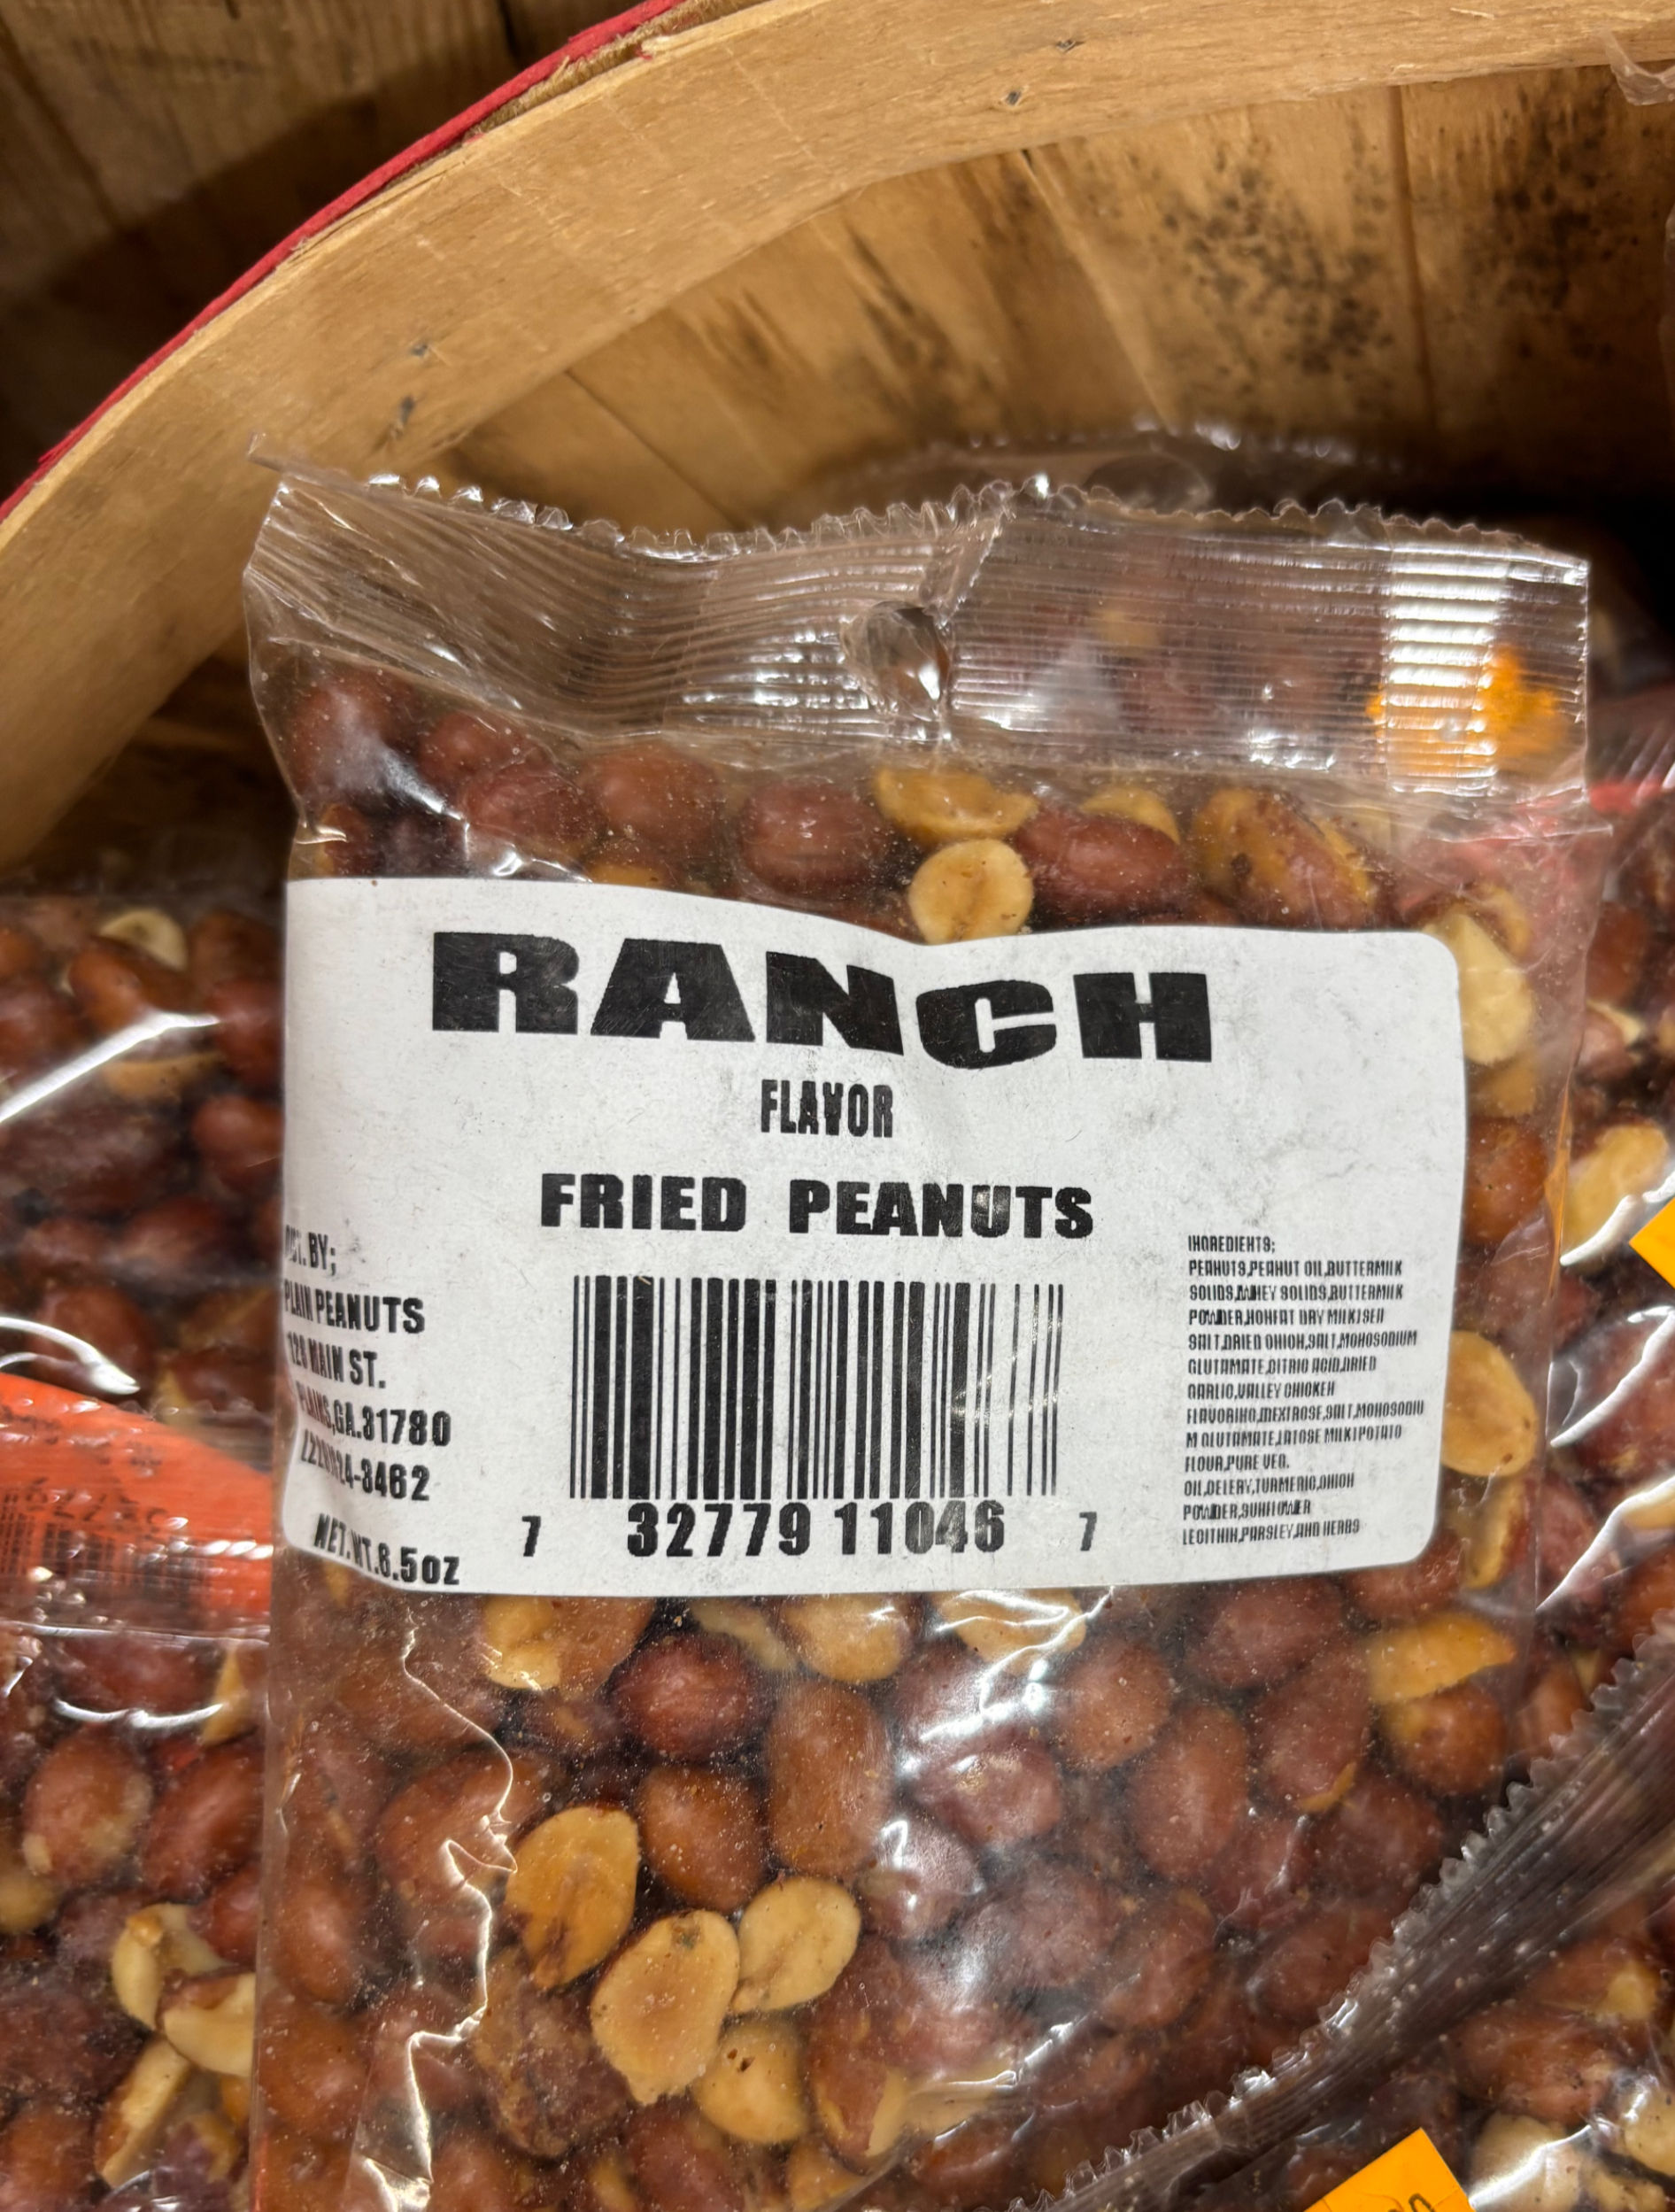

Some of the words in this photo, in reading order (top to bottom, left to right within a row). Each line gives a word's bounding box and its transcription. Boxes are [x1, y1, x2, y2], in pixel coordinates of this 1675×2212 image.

[432, 932, 1212, 1069] RANCH
[760, 1079, 893, 1138] FLAVOR
[540, 1173, 746, 1232] FRIED
[789, 1179, 1093, 1239] PEANUTS
[284, 1279, 313, 1322] PLAIN
[315, 1288, 425, 1334] PEANUTS
[1299, 1309, 1324, 1325] DRY
[308, 1338, 344, 1383] MAIN
[350, 1349, 386, 1388] ST.
[1284, 1381, 1336, 1398] CHICKEN
[1185, 1432, 1197, 1448] M
[522, 1515, 541, 1557] 7
[628, 1501, 810, 1557] 32779
[834, 1499, 1005, 1555] 11046
[1079, 1512, 1098, 1551] 7
